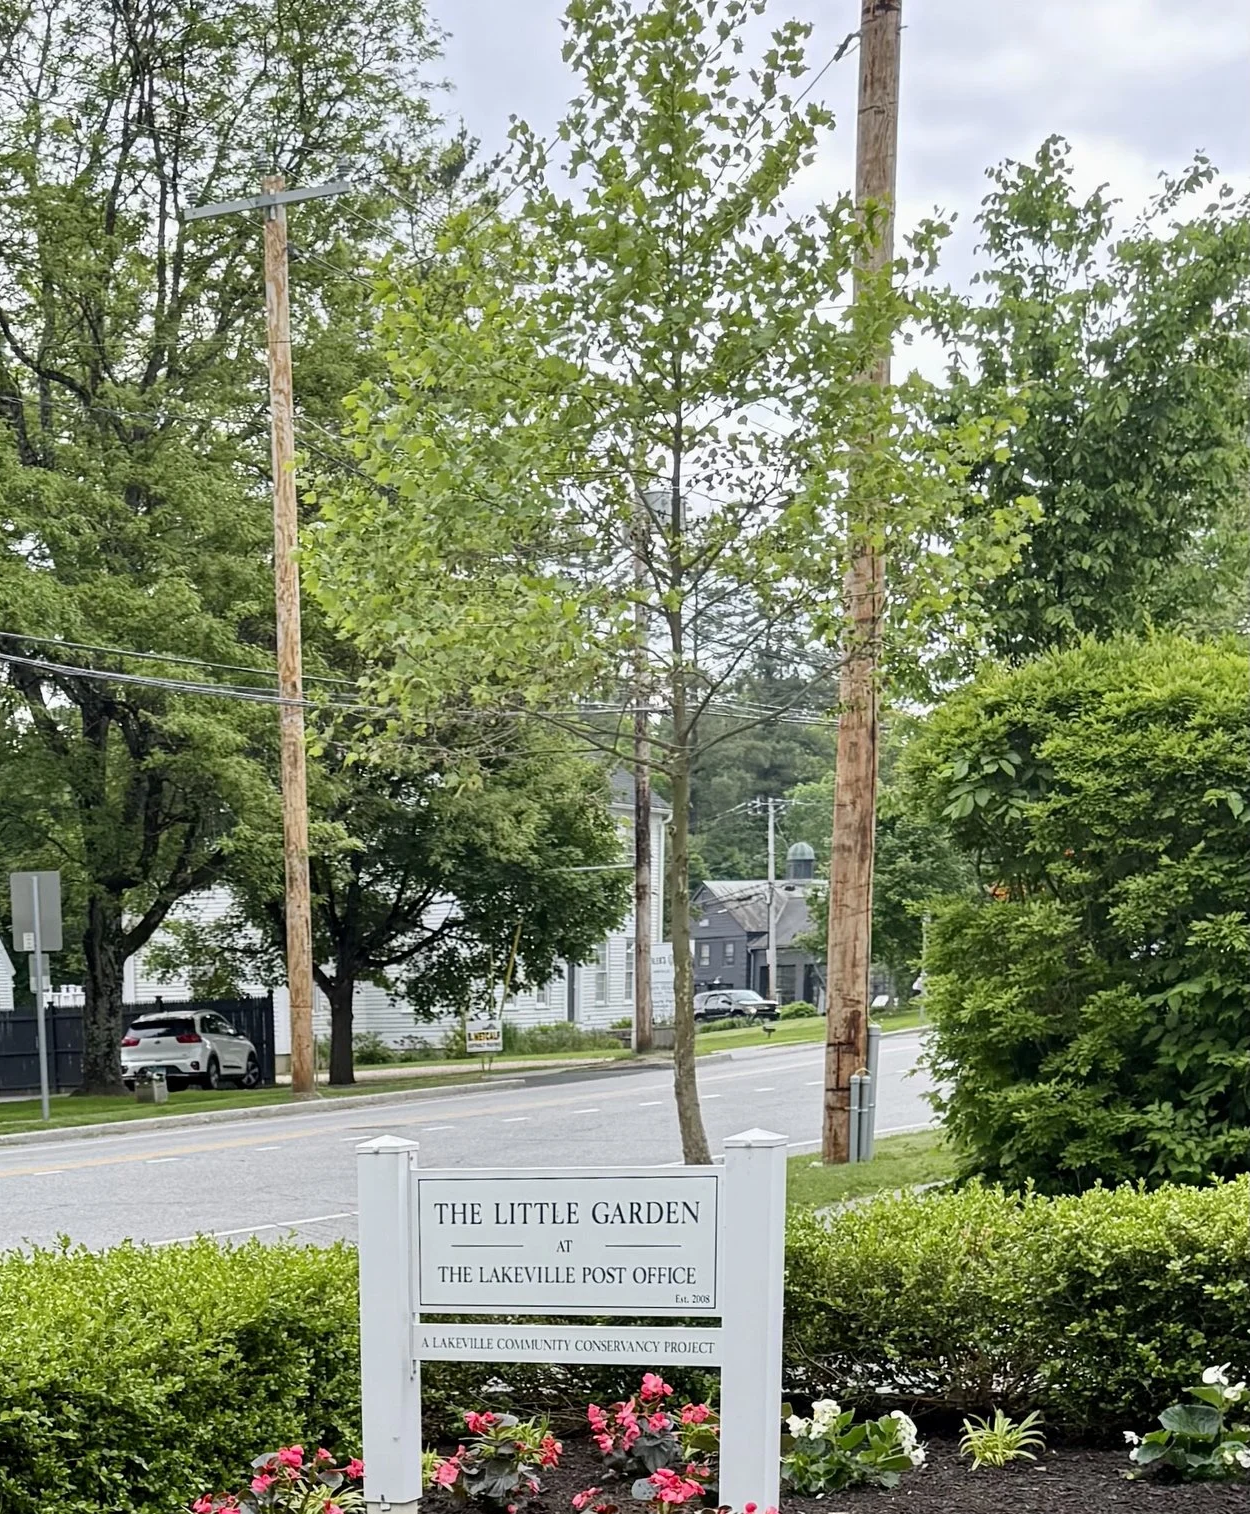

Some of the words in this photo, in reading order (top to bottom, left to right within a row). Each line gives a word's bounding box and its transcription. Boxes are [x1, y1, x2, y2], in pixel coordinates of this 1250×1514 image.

[434, 1203, 483, 1224] THE
[494, 1202, 579, 1224] LITTLE
[592, 1201, 700, 1224] GARDEN
[556, 1240, 573, 1253] AT
[437, 1266, 473, 1284] THE
[479, 1266, 576, 1284] LAKEVILLE
[582, 1266, 627, 1285] POST
[633, 1267, 697, 1285] OFFICE
[675, 1294, 690, 1304] Est.
[421, 1337, 430, 1348] A
[433, 1337, 494, 1350] LAKEVILLE
[496, 1338, 571, 1351] COMMUNITY
[575, 1339, 660, 1353] CONSERVANCY
[664, 1341, 715, 1354] PROJECT
